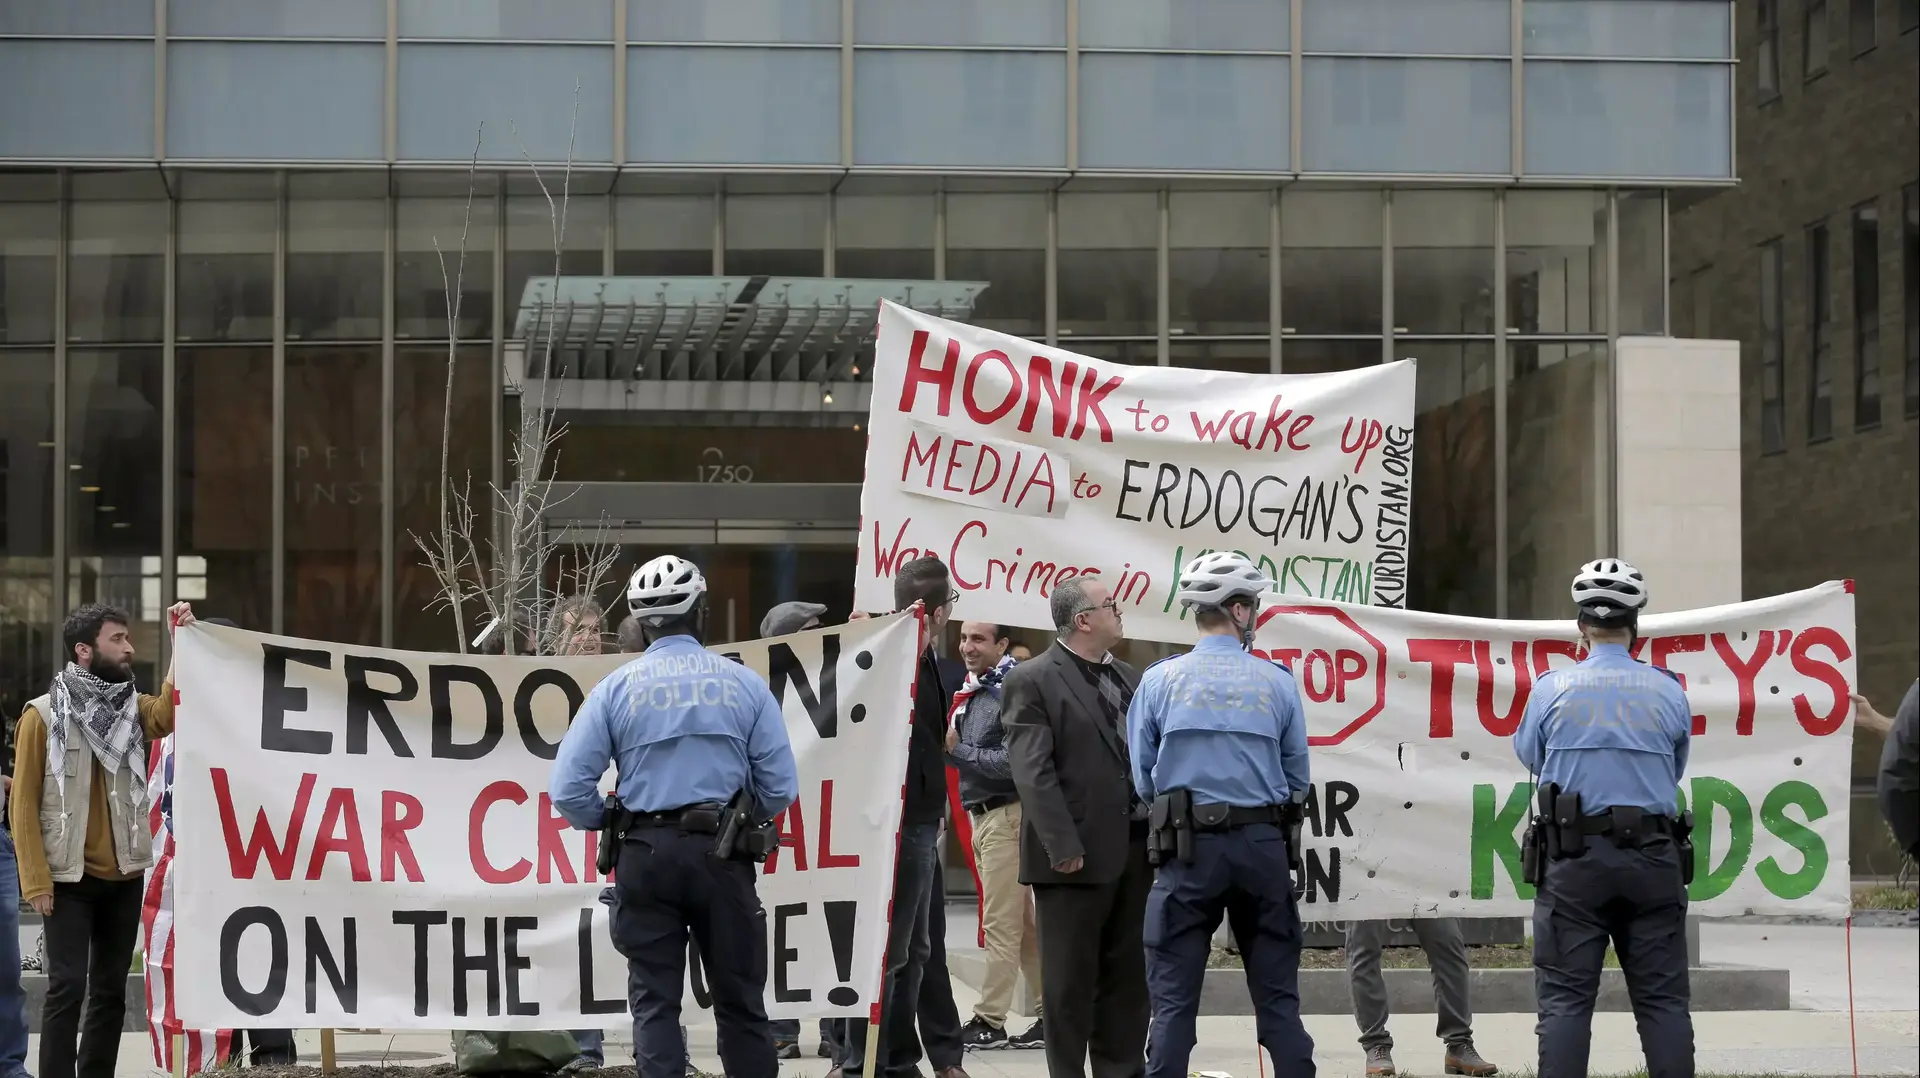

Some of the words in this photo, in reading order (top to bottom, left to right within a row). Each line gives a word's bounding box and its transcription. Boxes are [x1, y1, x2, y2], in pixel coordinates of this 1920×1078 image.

[898, 330, 1125, 443] HONK
[1125, 399, 1169, 432] to
[1190, 394, 1315, 452] wake
[1341, 416, 1383, 474] up
[698, 464, 753, 484] 1750
[901, 431, 1056, 513] MEDIA
[1073, 471, 1102, 500] to
[1115, 459, 1369, 546] ERDOGAN'S
[1373, 424, 1413, 609] KURDISTAN.ORG
[1112, 562, 1151, 606] in
[1163, 546, 1373, 620] KDISTAN
[261, 634, 873, 760] ERDON:
[629, 677, 741, 716] POLICE
[1251, 649, 1368, 703] TOP
[1407, 626, 1852, 738] TUEY'S
[209, 768, 425, 882] WAR
[469, 780, 860, 884] CRIAL
[1302, 781, 1360, 838] AR
[1471, 776, 1829, 902] KDS
[220, 906, 358, 1017] ON
[393, 910, 540, 1017] THE
